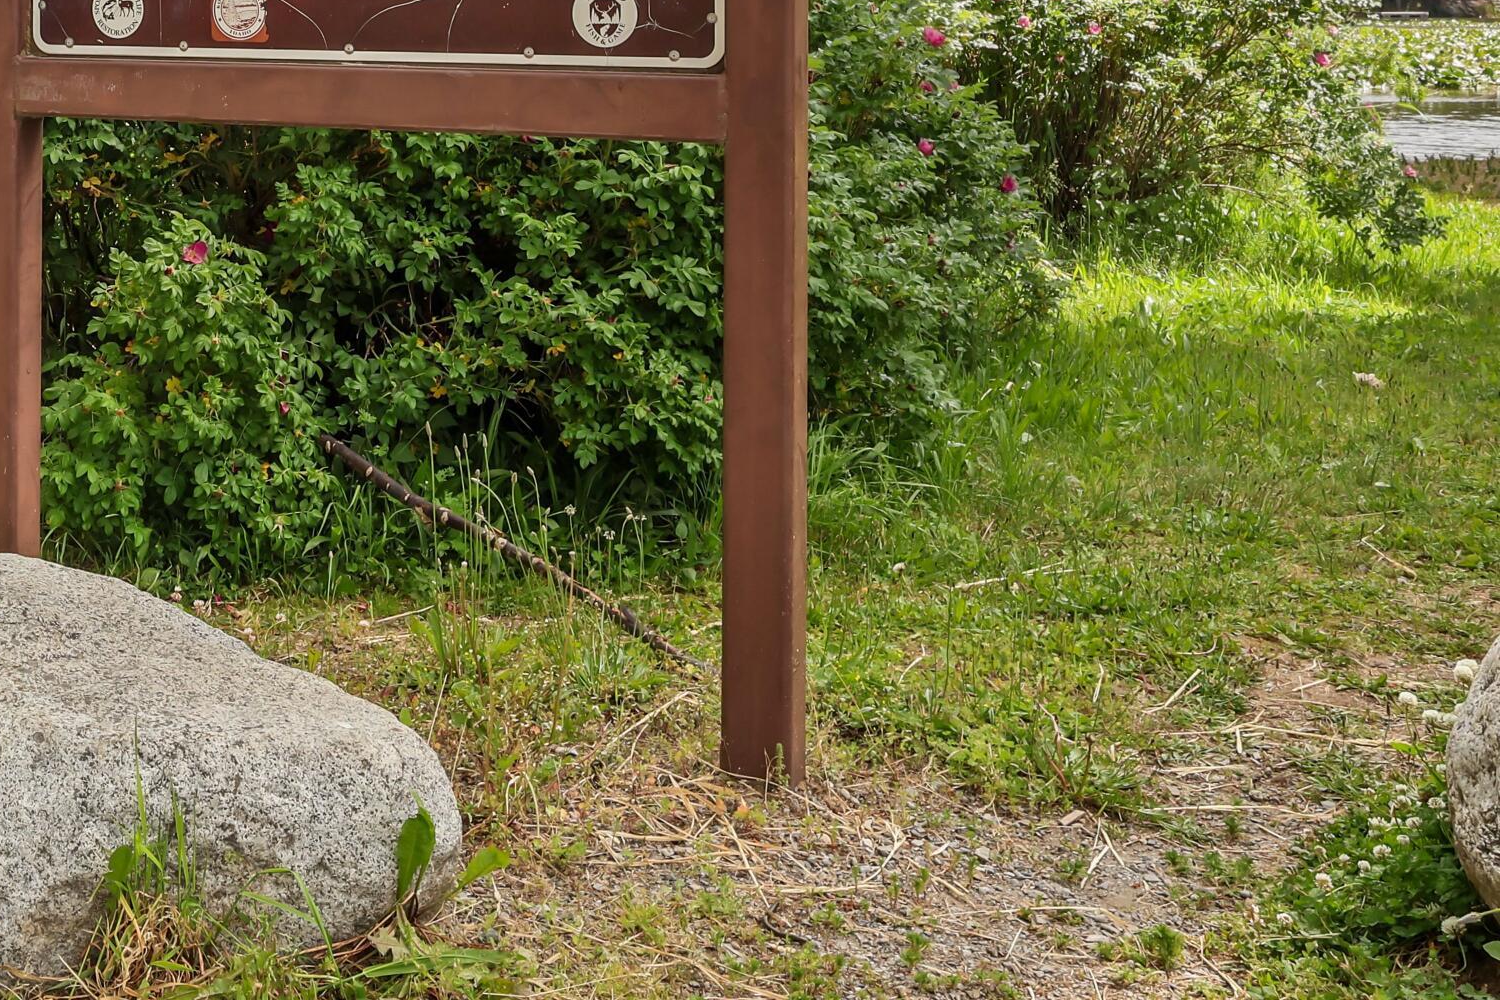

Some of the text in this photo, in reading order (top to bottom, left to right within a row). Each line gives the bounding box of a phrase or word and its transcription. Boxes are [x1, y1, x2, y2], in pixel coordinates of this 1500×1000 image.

[97, 19, 139, 36] RESTORATION
[586, 23, 600, 41] FISH
[608, 24, 625, 44] GAME
